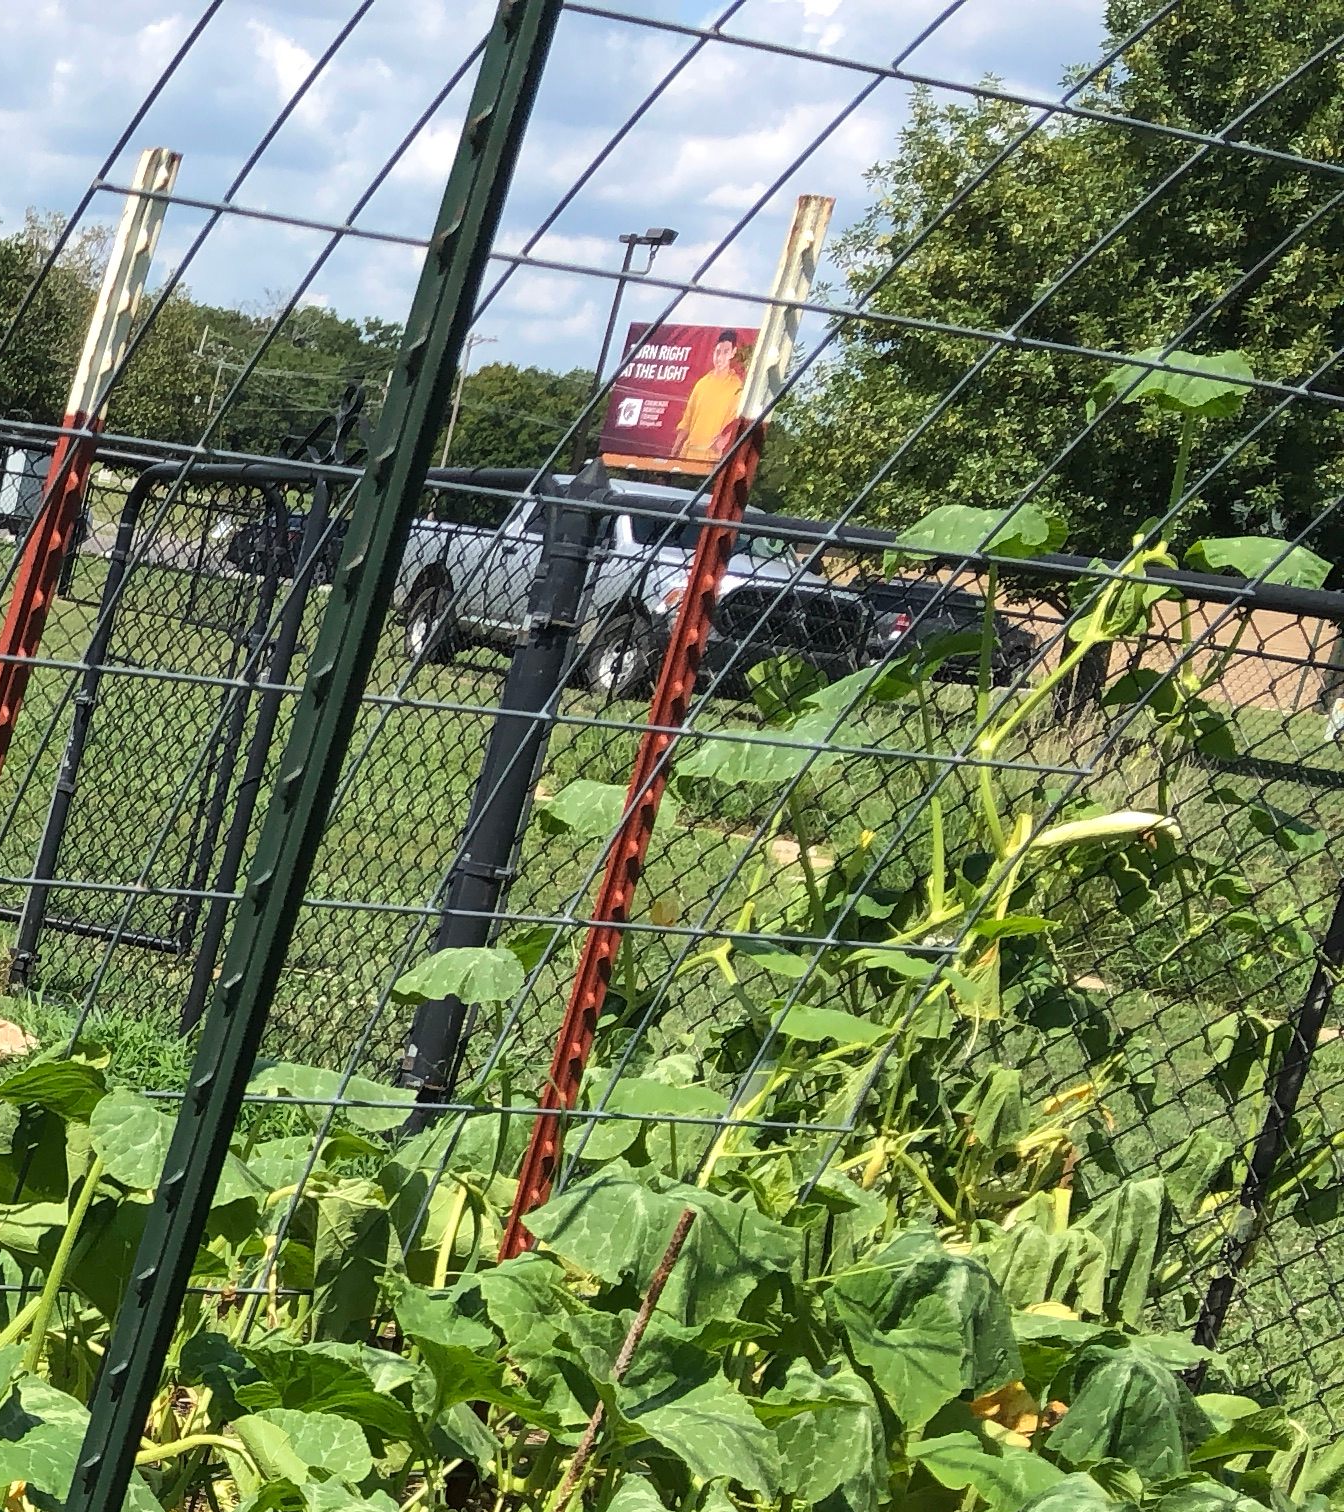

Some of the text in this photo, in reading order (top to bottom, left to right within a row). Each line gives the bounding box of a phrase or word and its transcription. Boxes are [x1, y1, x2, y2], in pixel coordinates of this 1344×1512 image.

[630, 343, 692, 361] URN RIGHT
[619, 363, 690, 382] AT THE LIGHT
